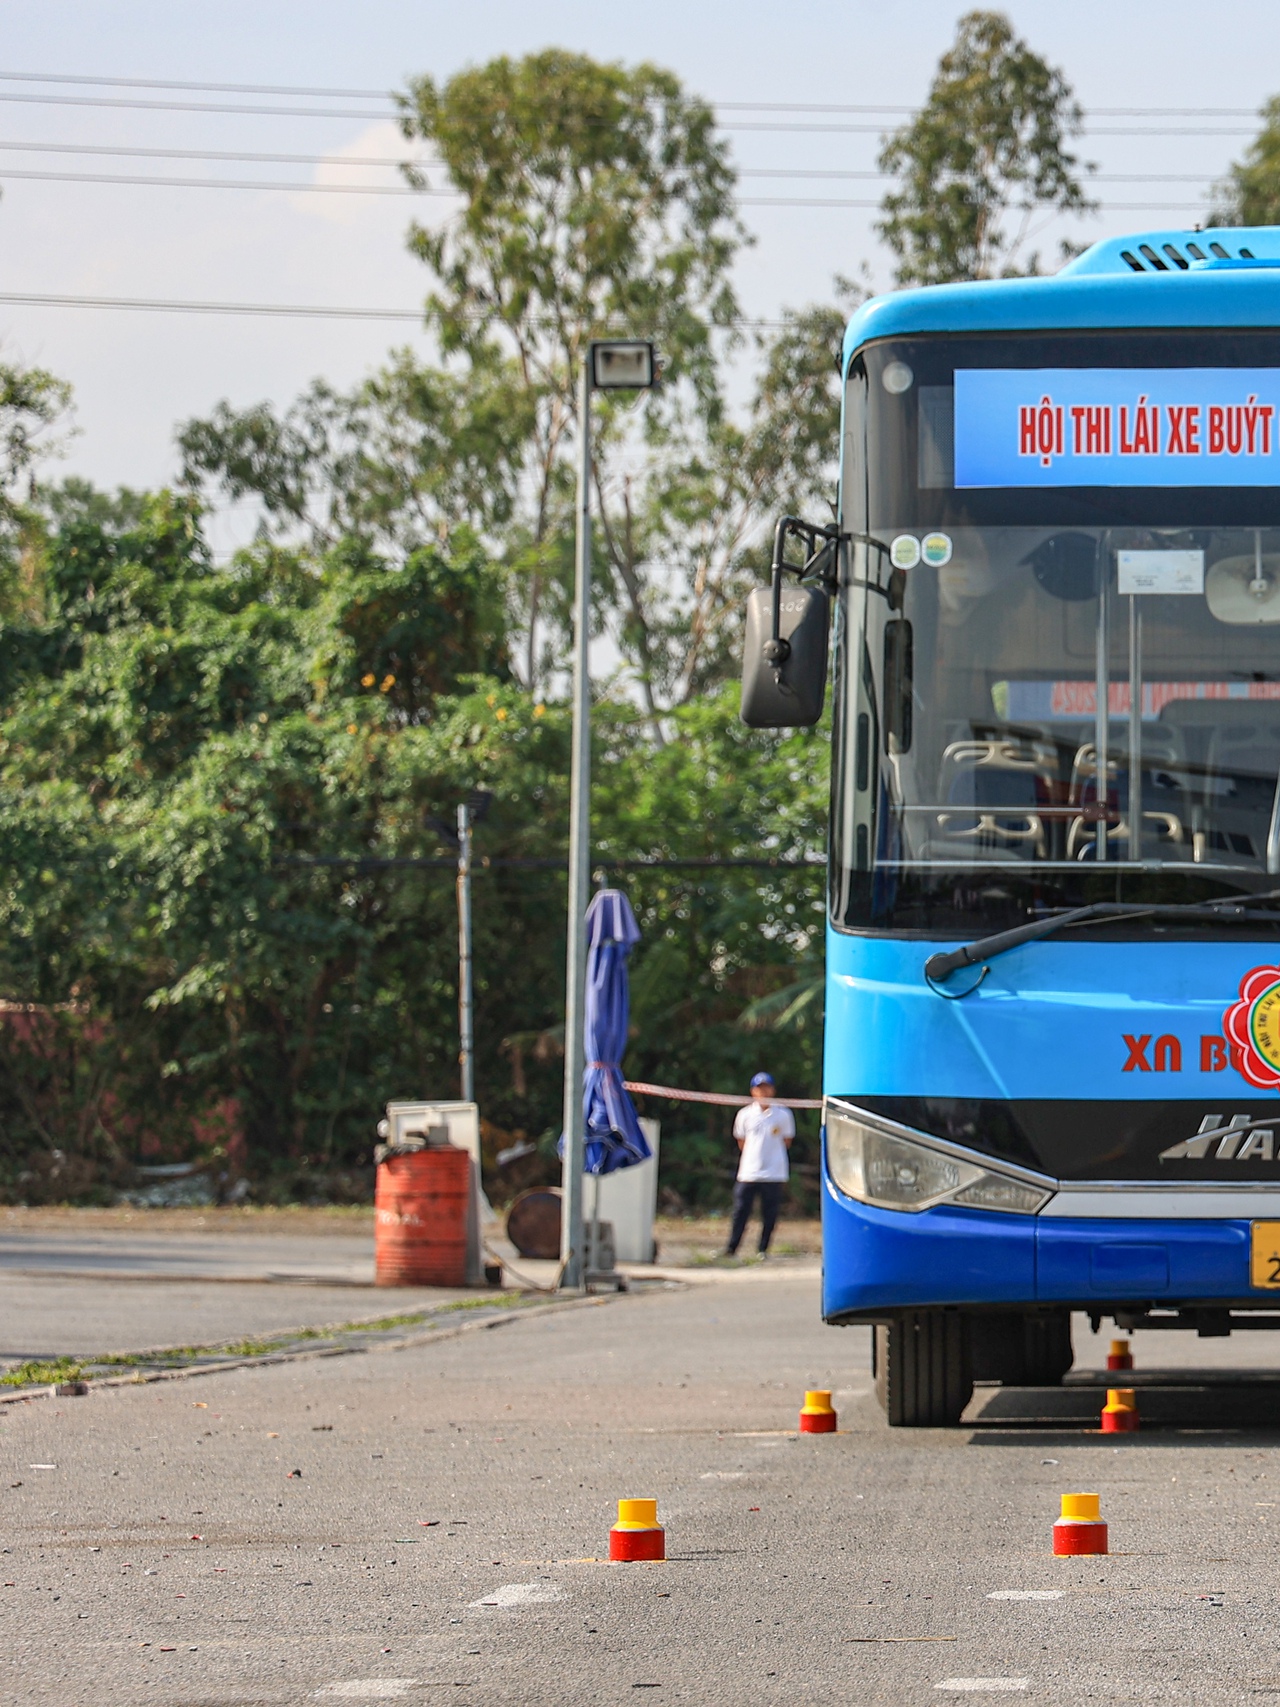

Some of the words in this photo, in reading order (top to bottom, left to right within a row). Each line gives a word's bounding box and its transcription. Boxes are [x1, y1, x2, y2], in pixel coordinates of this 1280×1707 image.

[1019, 396, 1064, 466] HỘI
[1071, 405, 1111, 455] THI
[1119, 396, 1159, 455] LÁI
[1166, 405, 1200, 455] XE
[1209, 395, 1274, 455] BUÝT
[1122, 1034, 1181, 1072] XN
